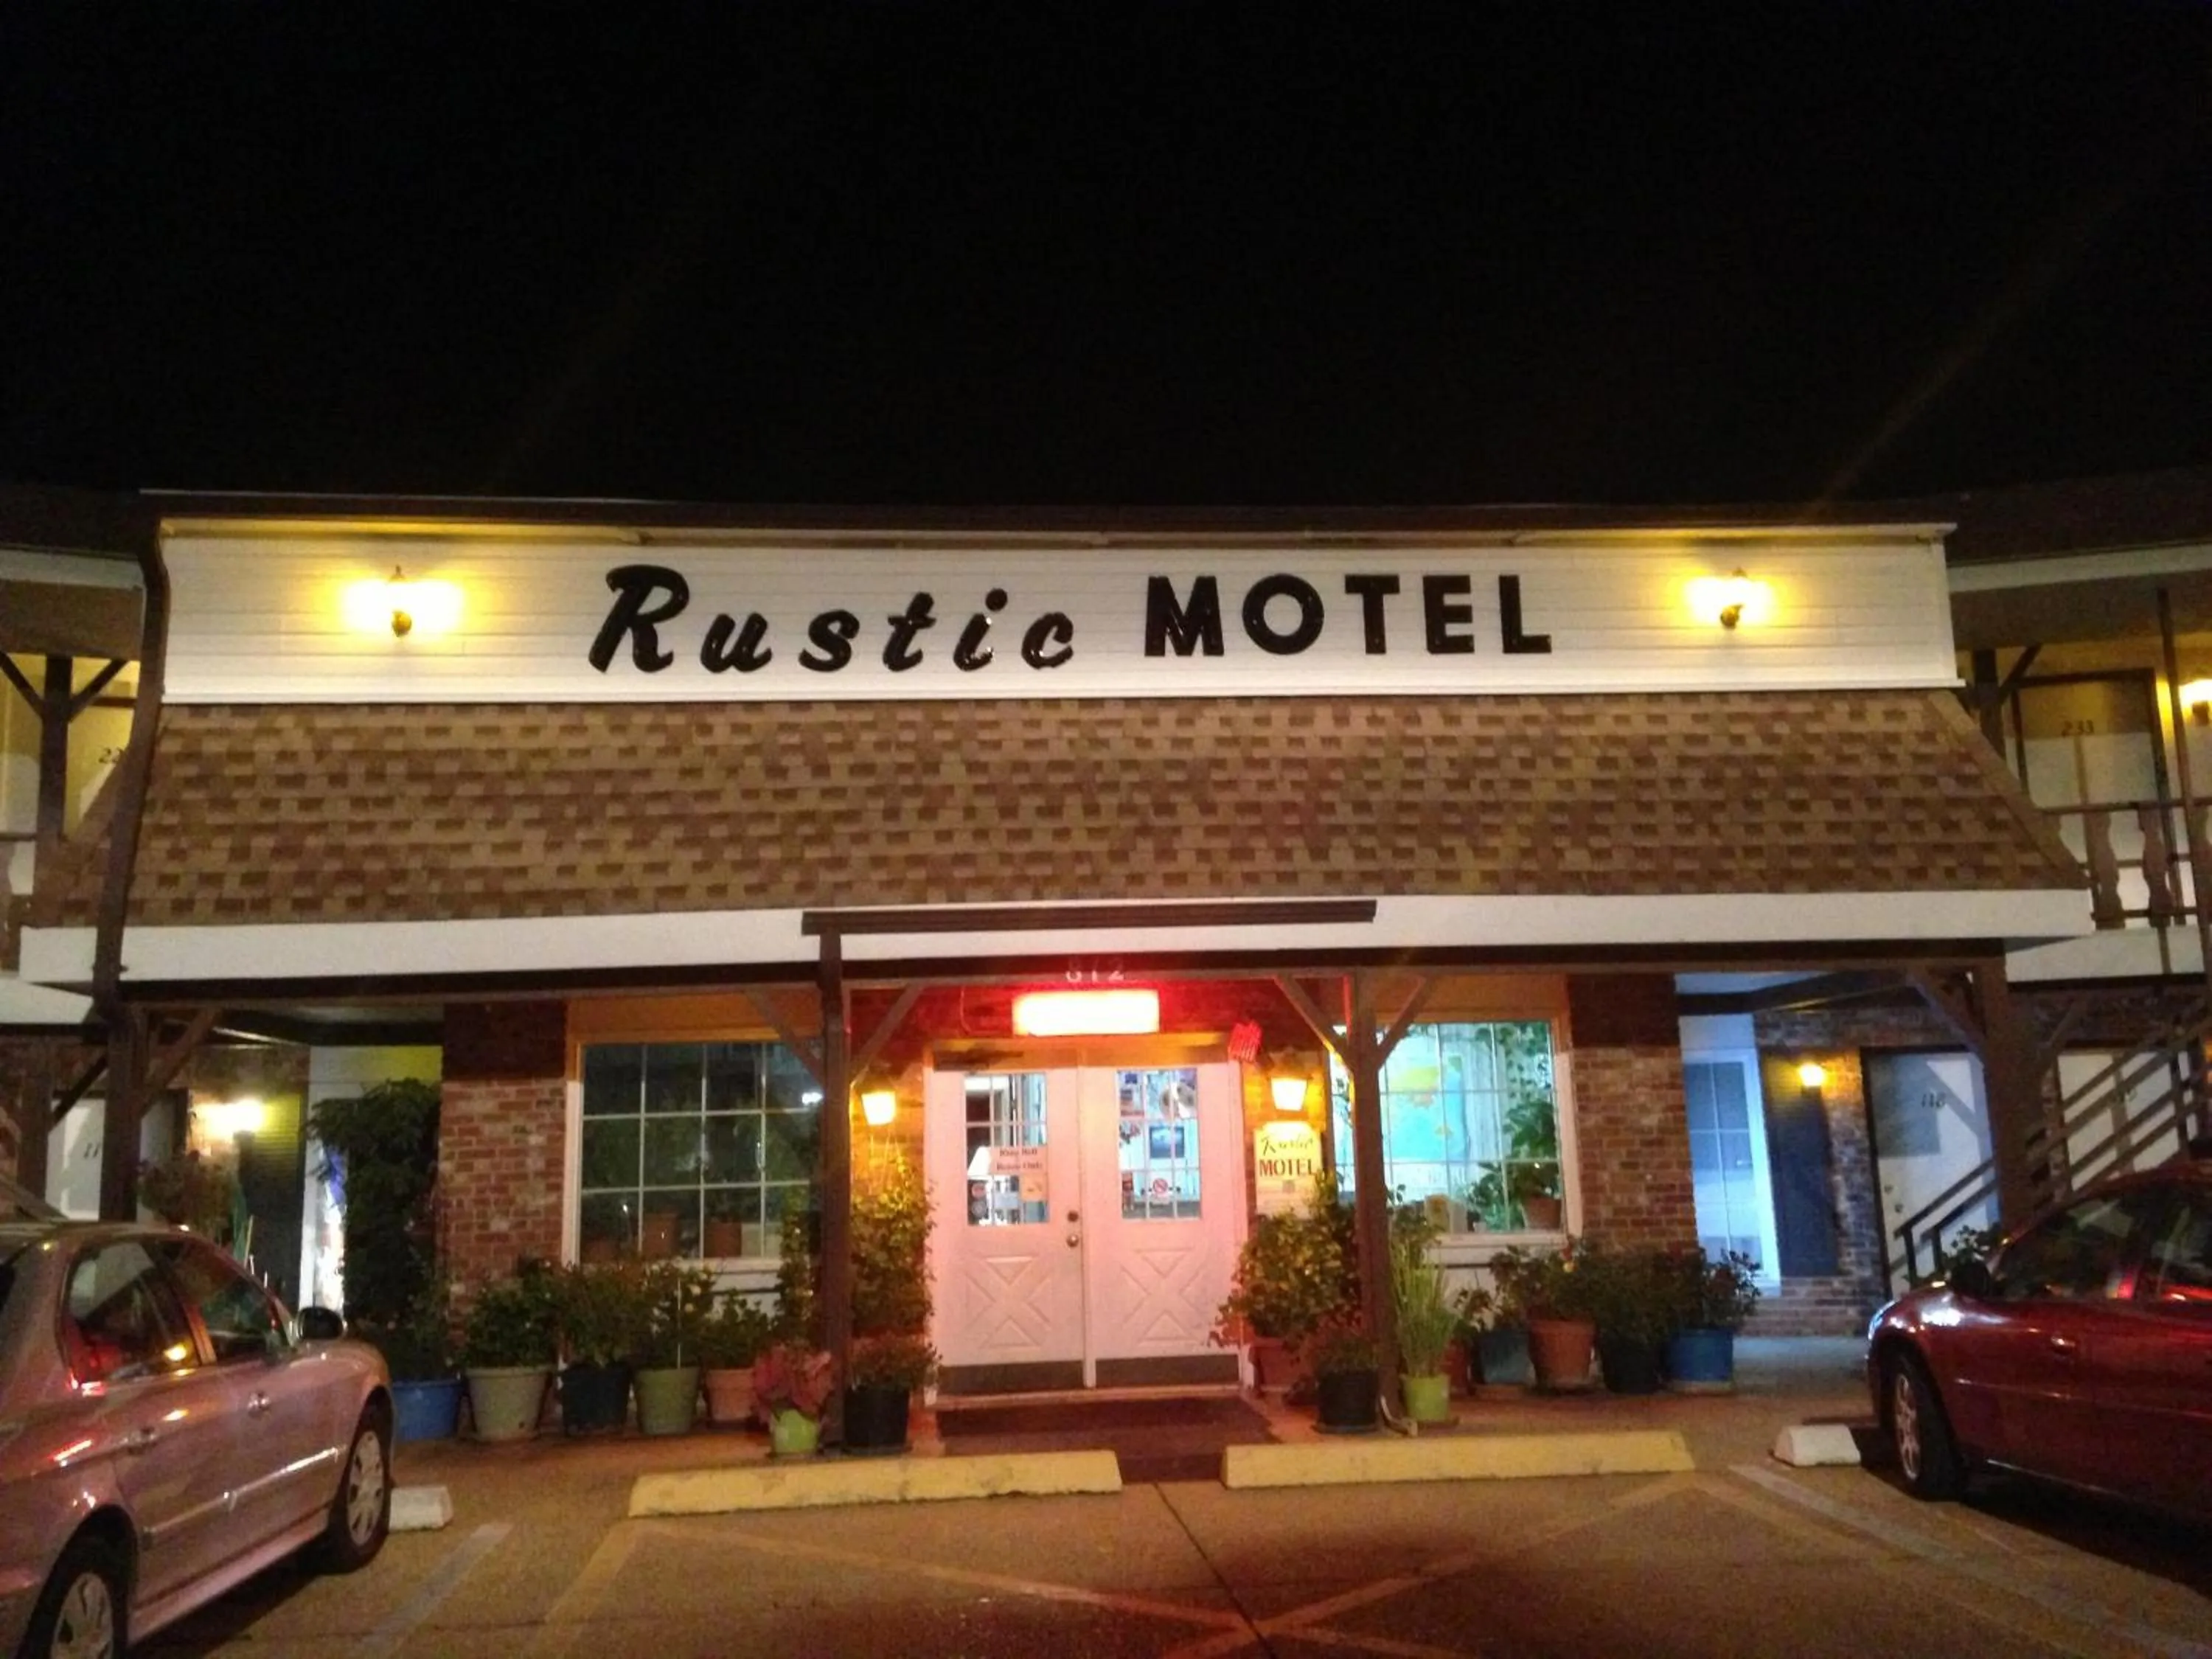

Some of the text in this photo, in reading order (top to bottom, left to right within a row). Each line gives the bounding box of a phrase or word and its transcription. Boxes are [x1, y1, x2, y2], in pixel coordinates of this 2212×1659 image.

[588, 564, 1552, 673] Rustic MOTEL
[1259, 1158, 1316, 1177] MOTEL
